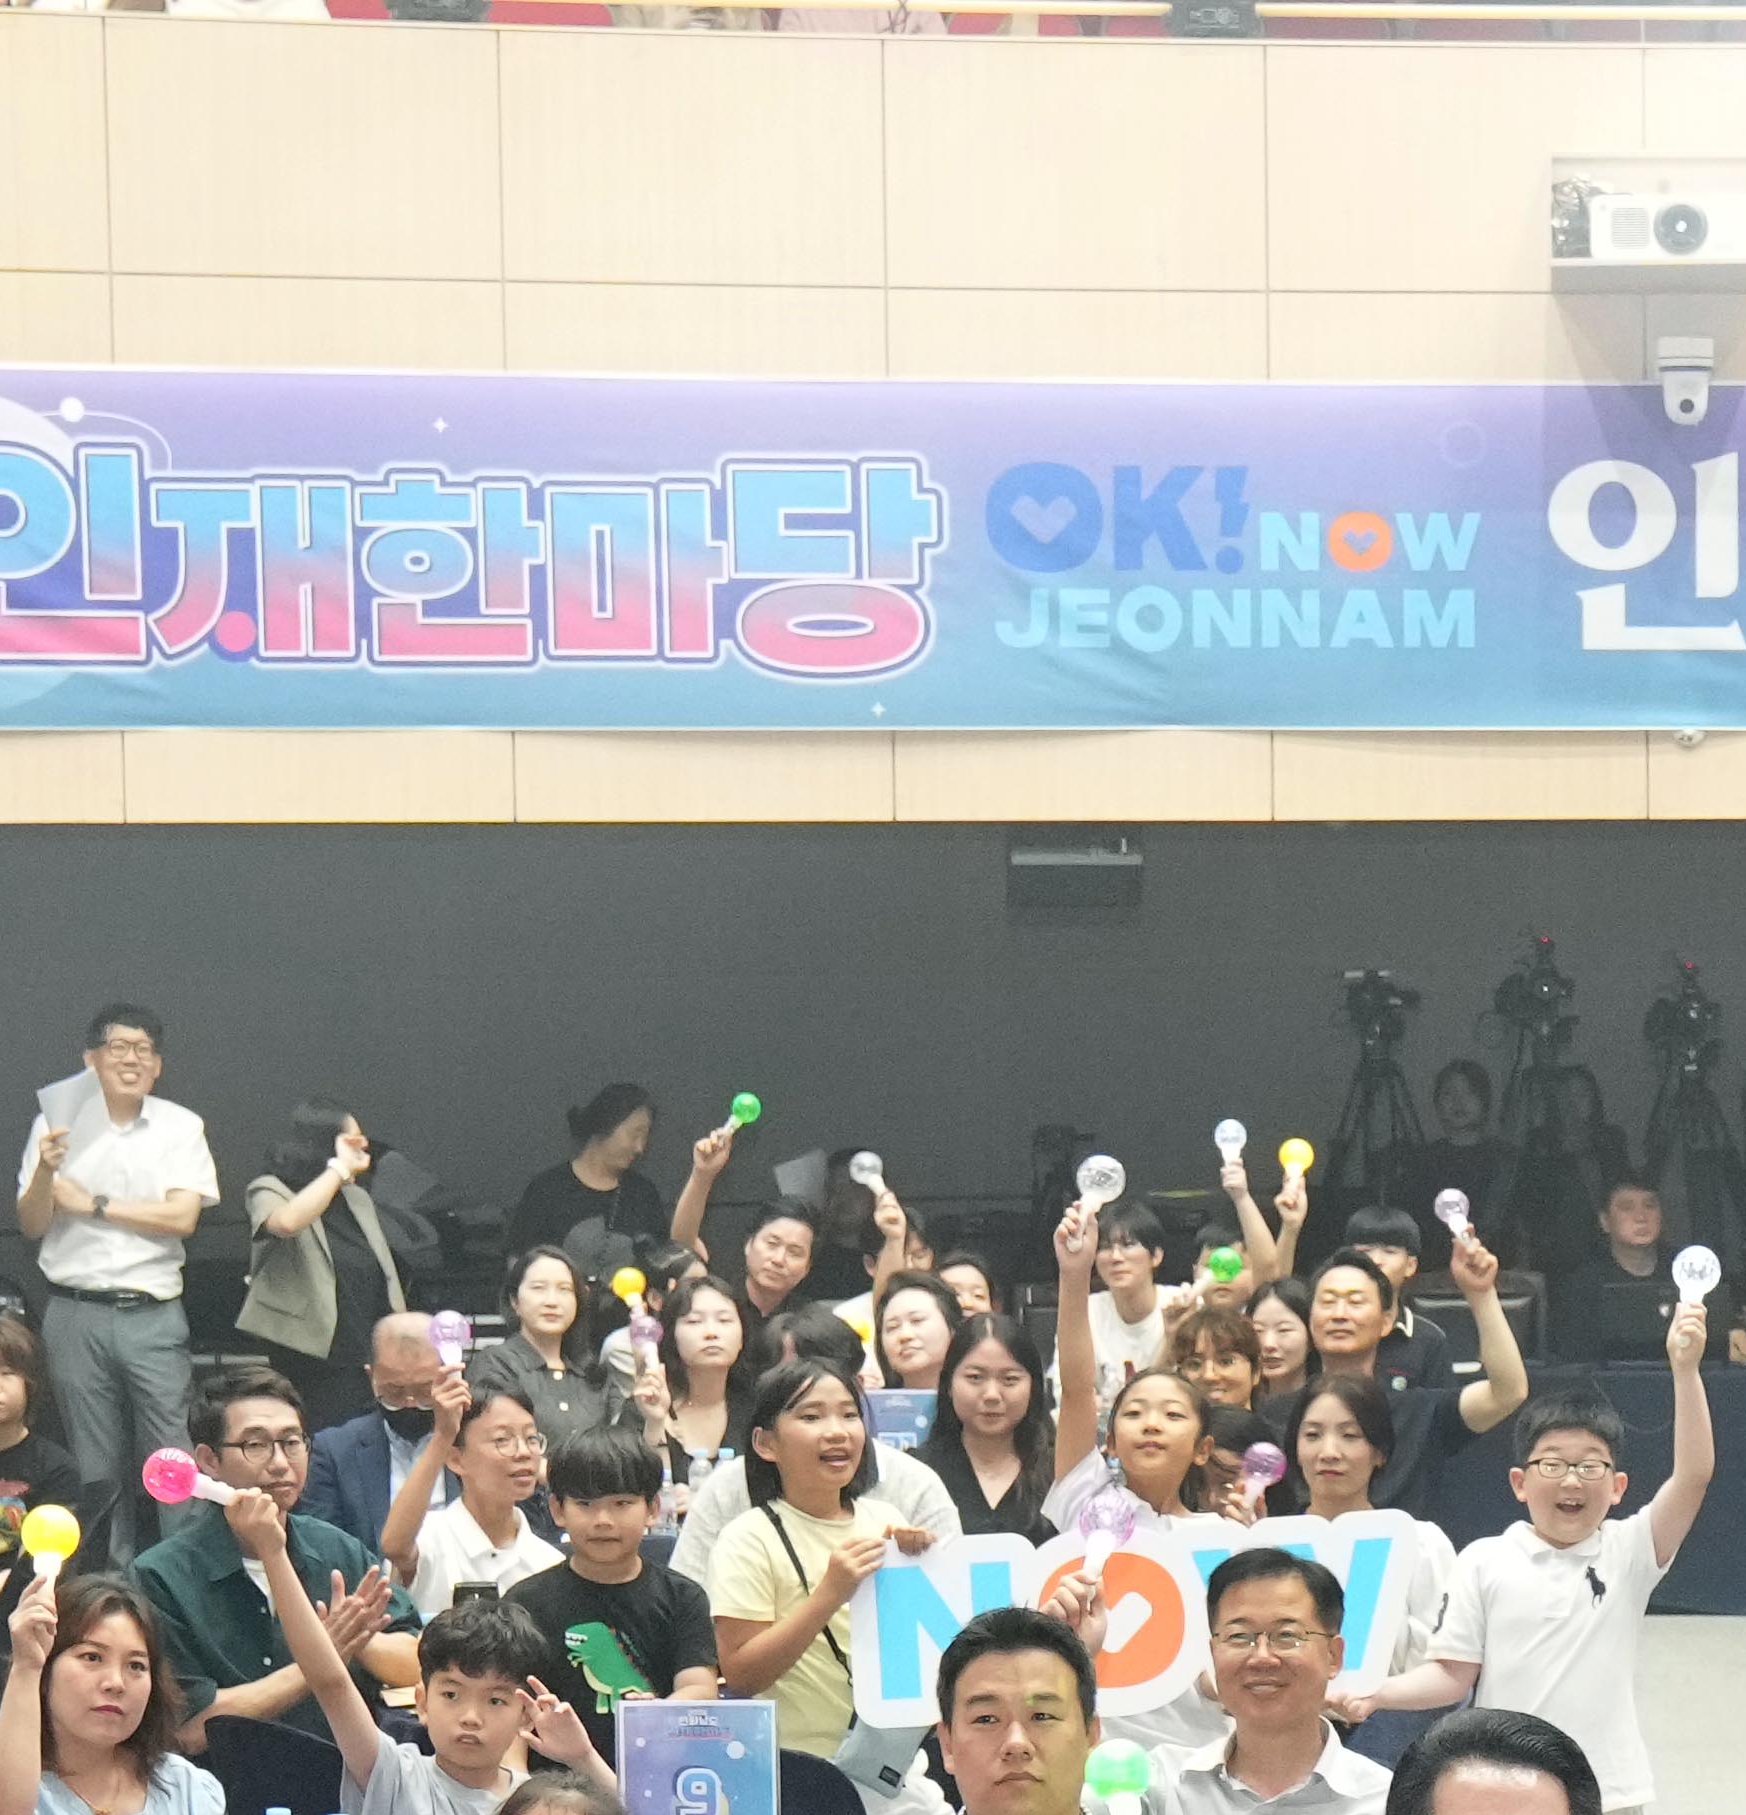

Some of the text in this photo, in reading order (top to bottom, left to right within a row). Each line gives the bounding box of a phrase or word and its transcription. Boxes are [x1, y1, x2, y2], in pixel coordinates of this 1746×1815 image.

[986, 463, 1482, 574] OK! NOW
[996, 586, 1478, 650] JEONNAM
